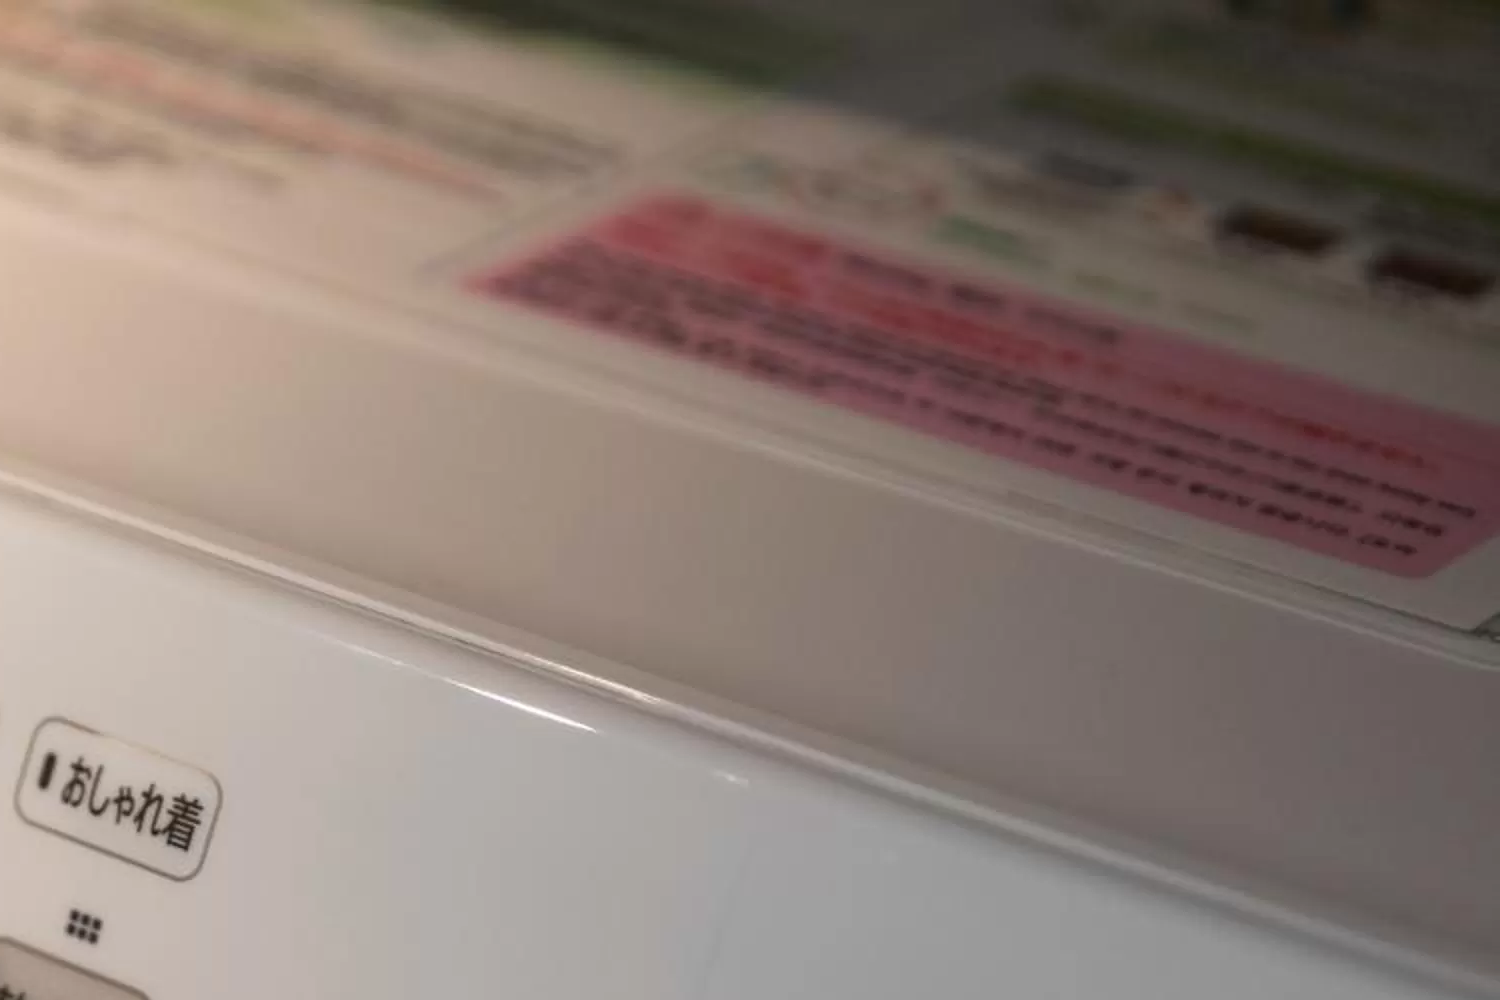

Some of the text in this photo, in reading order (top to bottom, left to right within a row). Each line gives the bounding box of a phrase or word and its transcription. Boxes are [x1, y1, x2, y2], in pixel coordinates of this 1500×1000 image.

[61, 755, 206, 853] おしゃれ着
